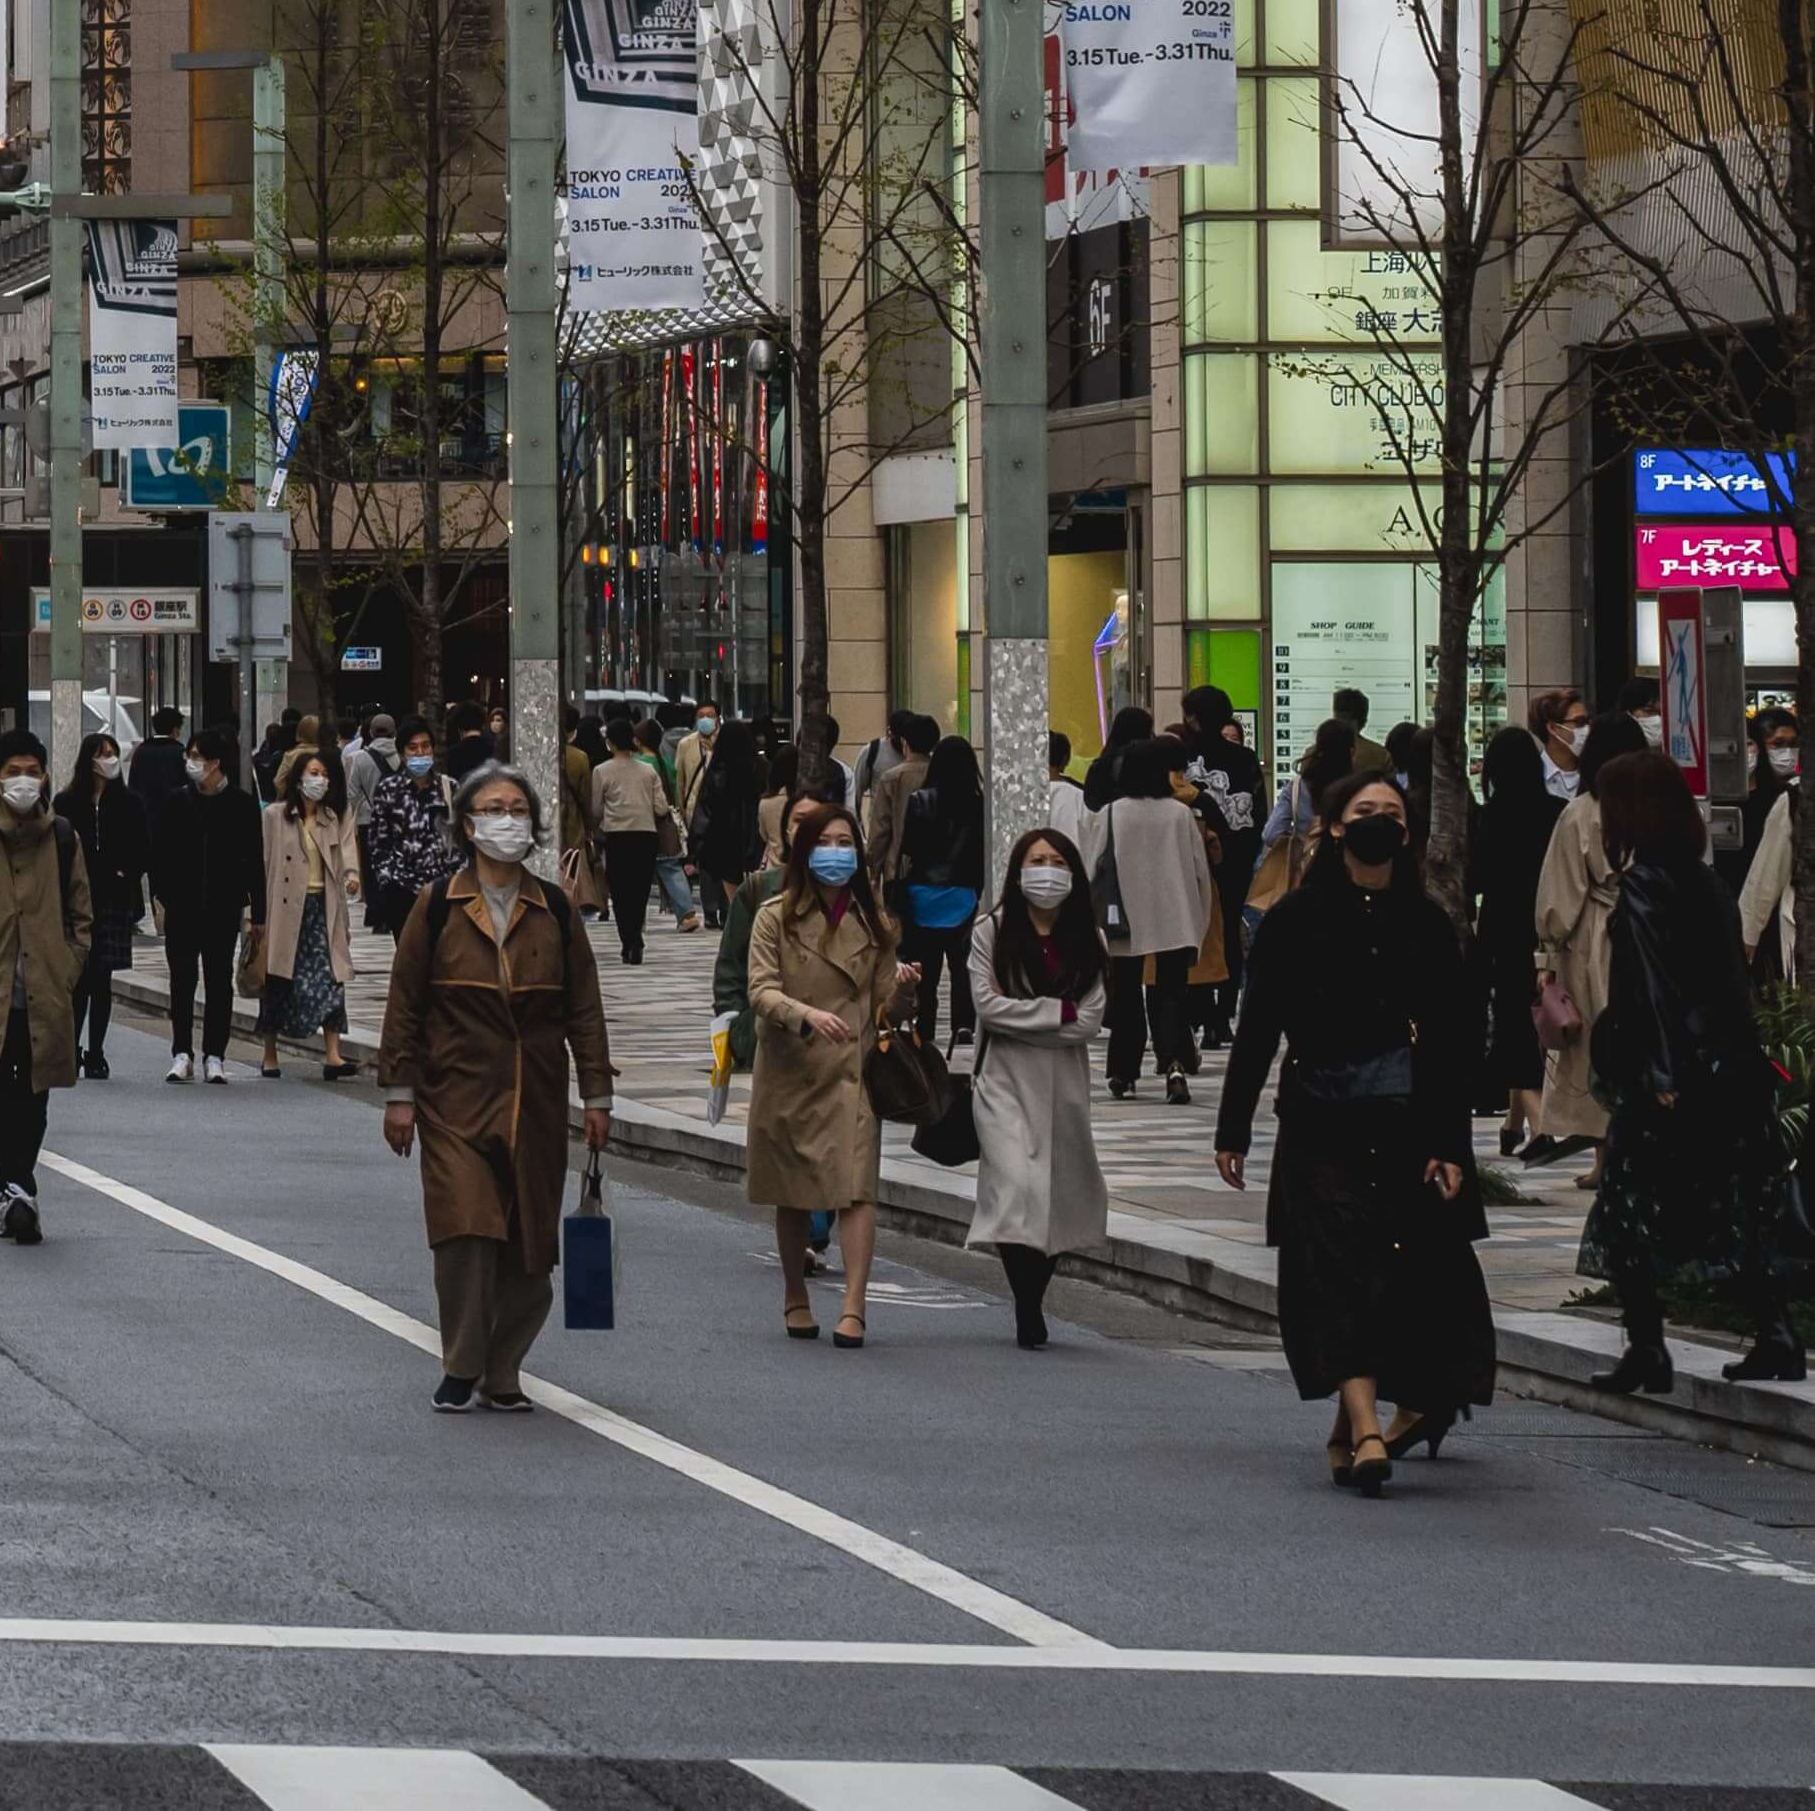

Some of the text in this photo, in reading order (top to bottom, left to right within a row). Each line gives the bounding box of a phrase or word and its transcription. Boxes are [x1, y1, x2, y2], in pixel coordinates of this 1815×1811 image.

[1065, 1, 1231, 22] SALON 2022
[618, 33, 682, 50] GINZA
[574, 60, 659, 85] GINZA
[570, 169, 697, 183] TOKYO CREATIVE
[570, 185, 695, 199] SALON 2022
[597, 265, 694, 278] ヒューリック株式会社
[96, 281, 151, 298] GINZA
[1355, 310, 1398, 333] 銀座
[93, 354, 175, 363] TOKYO CREATIVE
[93, 365, 175, 374] SALON 2022
[1331, 385, 1426, 406] CITY CLUB
[1640, 454, 1657, 468] 8F
[1653, 473, 1767, 492] アートネイチャ
[1641, 529, 1657, 543] 7F
[1683, 538, 1763, 556] レディース
[1660, 559, 1781, 577] アートネイチャー
[155, 601, 187, 612] 銀座駅
